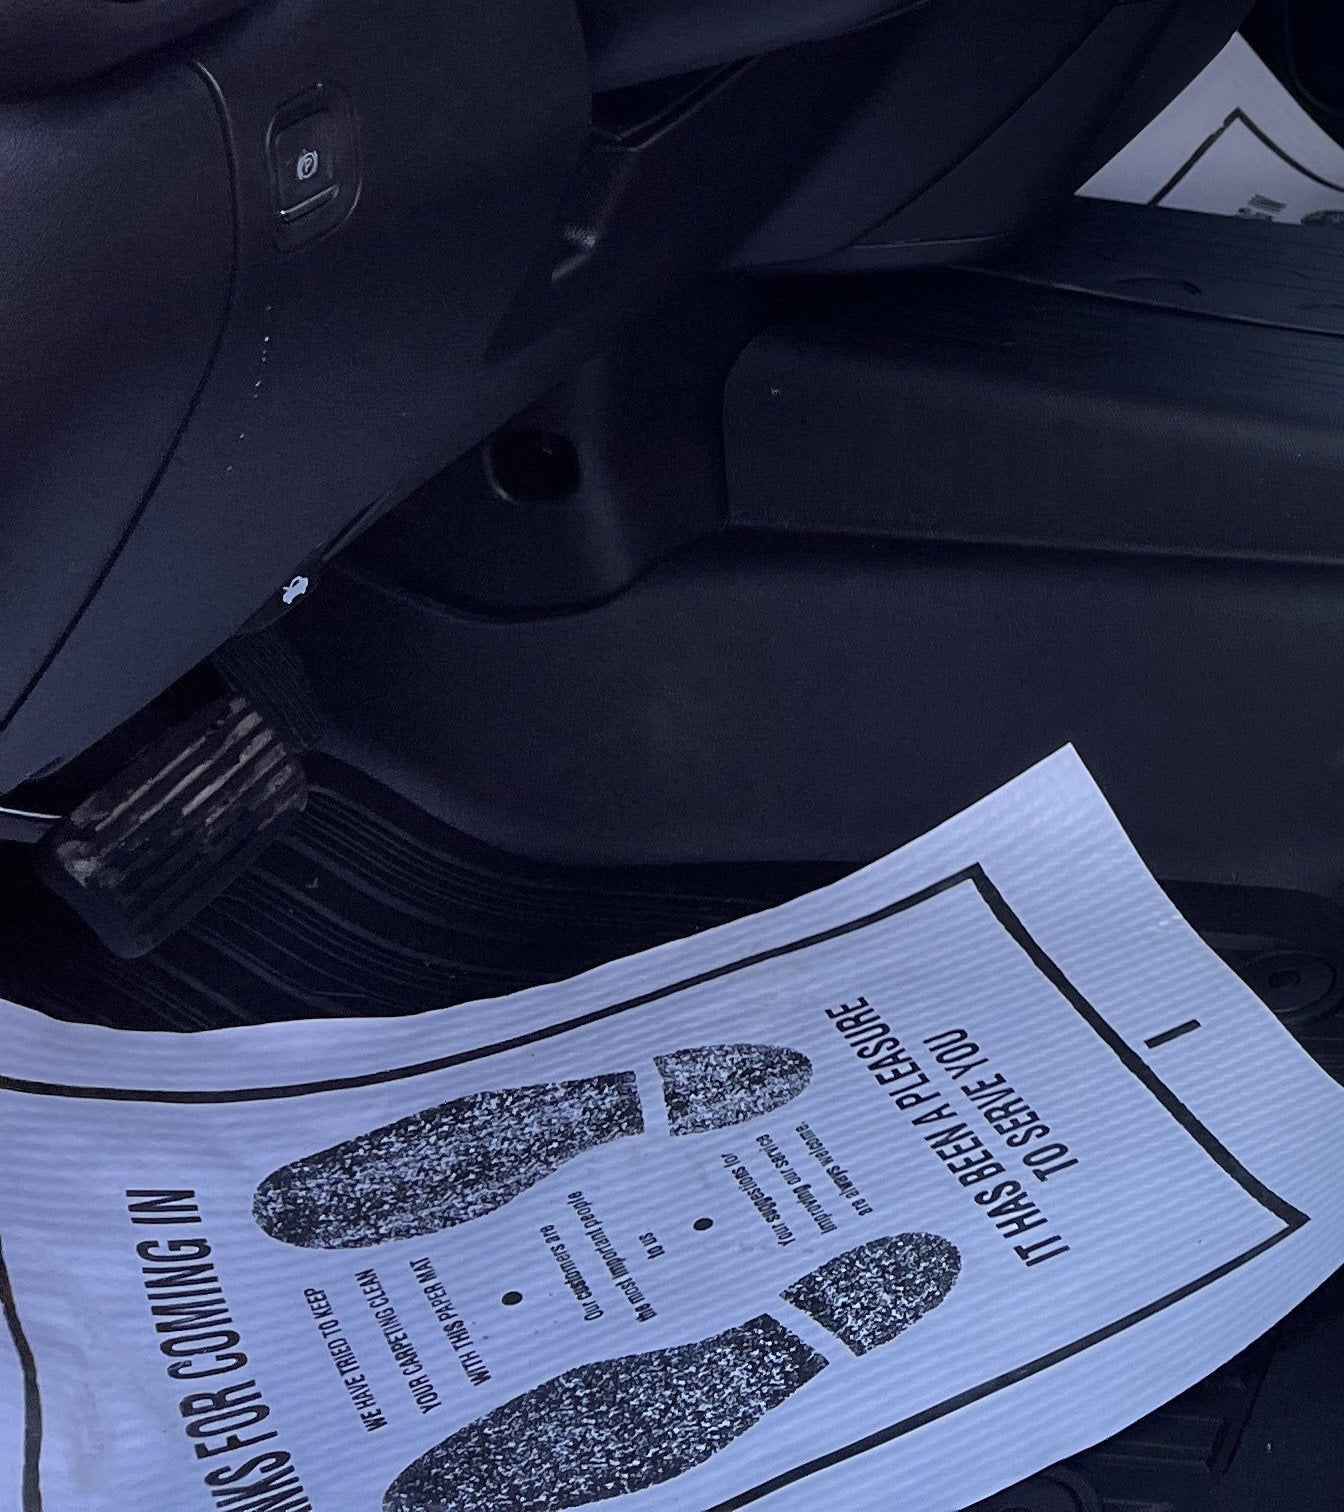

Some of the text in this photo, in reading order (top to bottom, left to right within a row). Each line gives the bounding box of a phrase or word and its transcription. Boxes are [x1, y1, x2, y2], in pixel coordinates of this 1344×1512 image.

[824, 996, 1071, 1267] IT HAS BEEN A PLEASURE
[922, 1028, 1079, 1182] TO SERVE YOU
[756, 1134, 789, 1169] service
[780, 1167, 802, 1186] our
[125, 1189, 202, 1225] IN
[567, 1191, 603, 1229] people
[721, 1152, 796, 1247] Your suggestions for
[826, 1165, 860, 1199] always
[851, 1198, 874, 1217] are
[540, 1224, 604, 1321] Our customers are
[639, 1232, 666, 1260] to us
[136, 1238, 249, 1380] COMING
[615, 1277, 646, 1305] most
[635, 1303, 658, 1323] the
[354, 1268, 442, 1415] YOUR CARPETING CLEAN
[409, 1257, 492, 1387] WITH THIS PAPER MAT
[303, 1287, 388, 1432] WE HAVE TRIED TO KEEP
[179, 1379, 279, 1460] FOR
